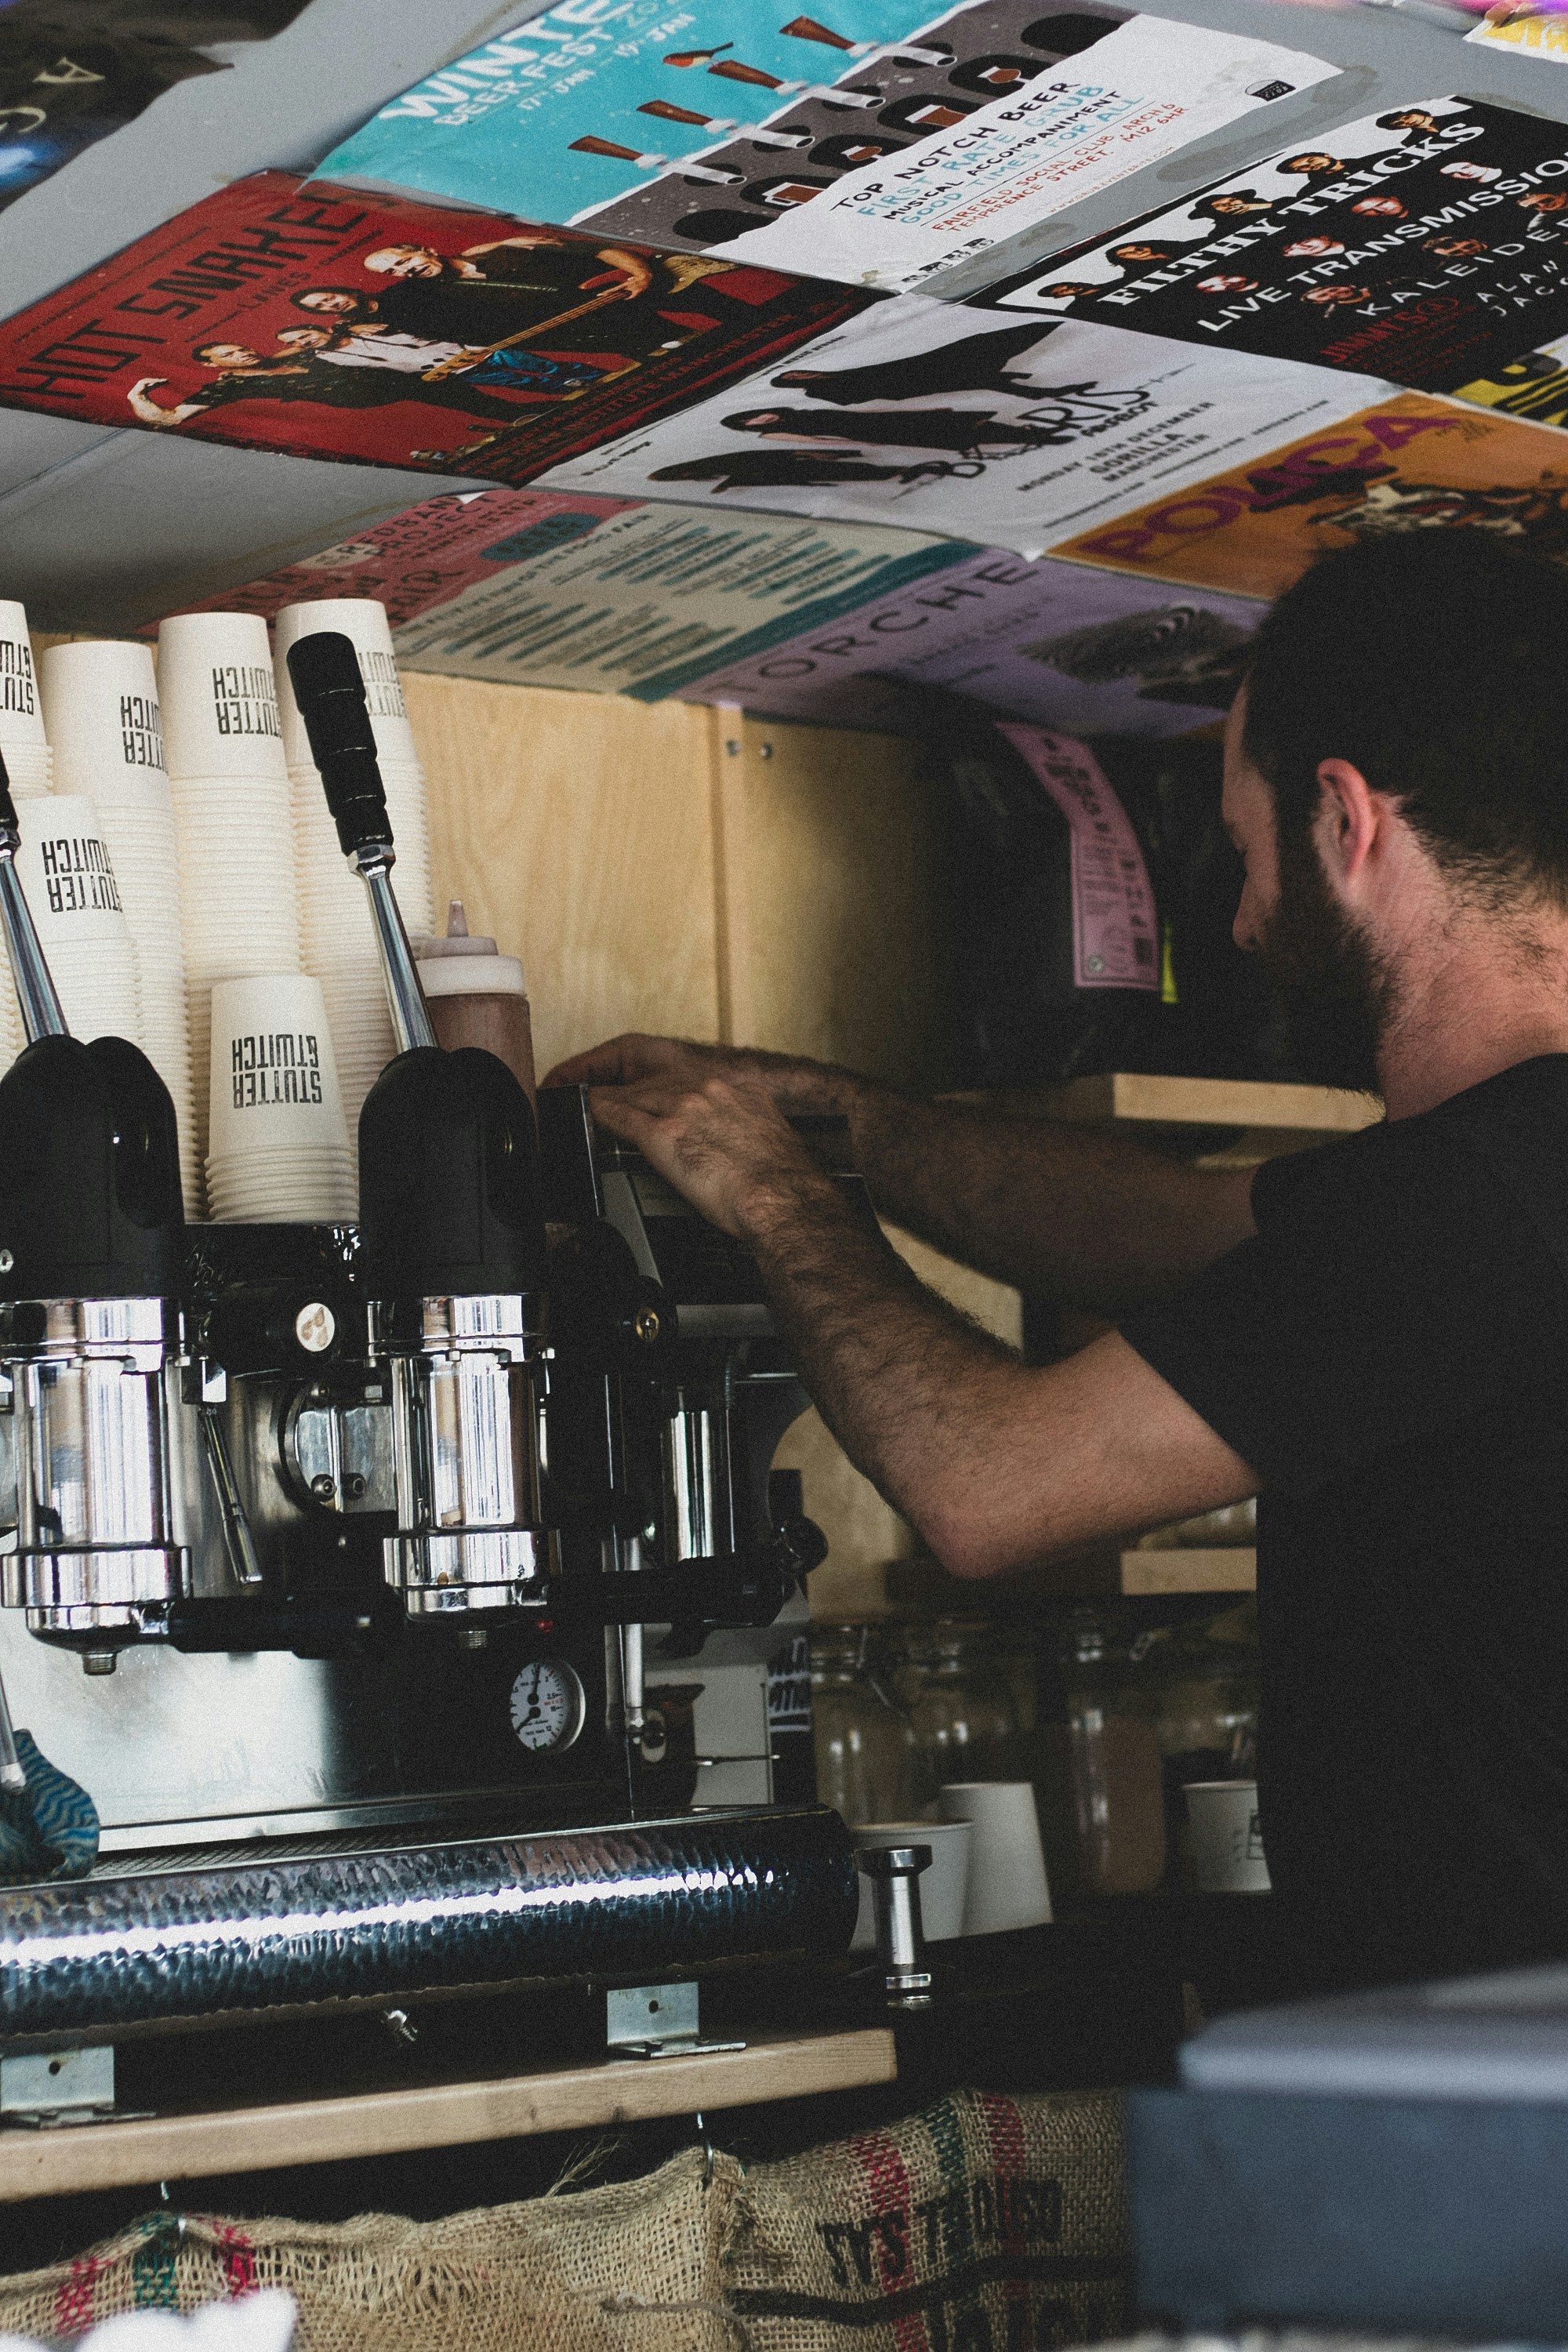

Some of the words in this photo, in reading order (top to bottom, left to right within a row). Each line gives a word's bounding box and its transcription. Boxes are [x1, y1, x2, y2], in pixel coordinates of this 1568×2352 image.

[433, 80, 533, 126] BEER
[521, 25, 613, 79] FEST
[829, 183, 884, 211] TOP
[894, 127, 998, 180] NOTCH
[998, 82, 1081, 122] BEER
[857, 176, 933, 216] FIRST
[942, 133, 1017, 171] RATE
[1024, 86, 1104, 127] GRUB
[882, 180, 964, 220] MUSICAL
[967, 90, 1121, 176] ACCOMPANIMENT
[900, 192, 963, 223] GOOD
[966, 151, 1040, 187] TIMES
[1044, 123, 1095, 147] FOR
[1098, 97, 1144, 122] ALL
[931, 189, 1012, 230] FAIRFIELD
[1016, 159, 1072, 187] SOCIAL
[1122, 108, 1163, 131] ARCH
[946, 183, 1044, 232] TEMPERENCE
[1096, 218, 1287, 305] FILTHY
[1276, 123, 1485, 216] TRICKS
[1197, 286, 1291, 332] LIVE
[1287, 151, 1568, 284] TRANSMISSIO
[0, 318, 166, 399] HOT
[114, 187, 400, 320] SNAKES
[1089, 433, 1185, 473] GORILLA
[364, 497, 497, 557] PROJECT
[709, 561, 1040, 695] TORCHE
[233, 1069, 322, 1109] STUTTER
